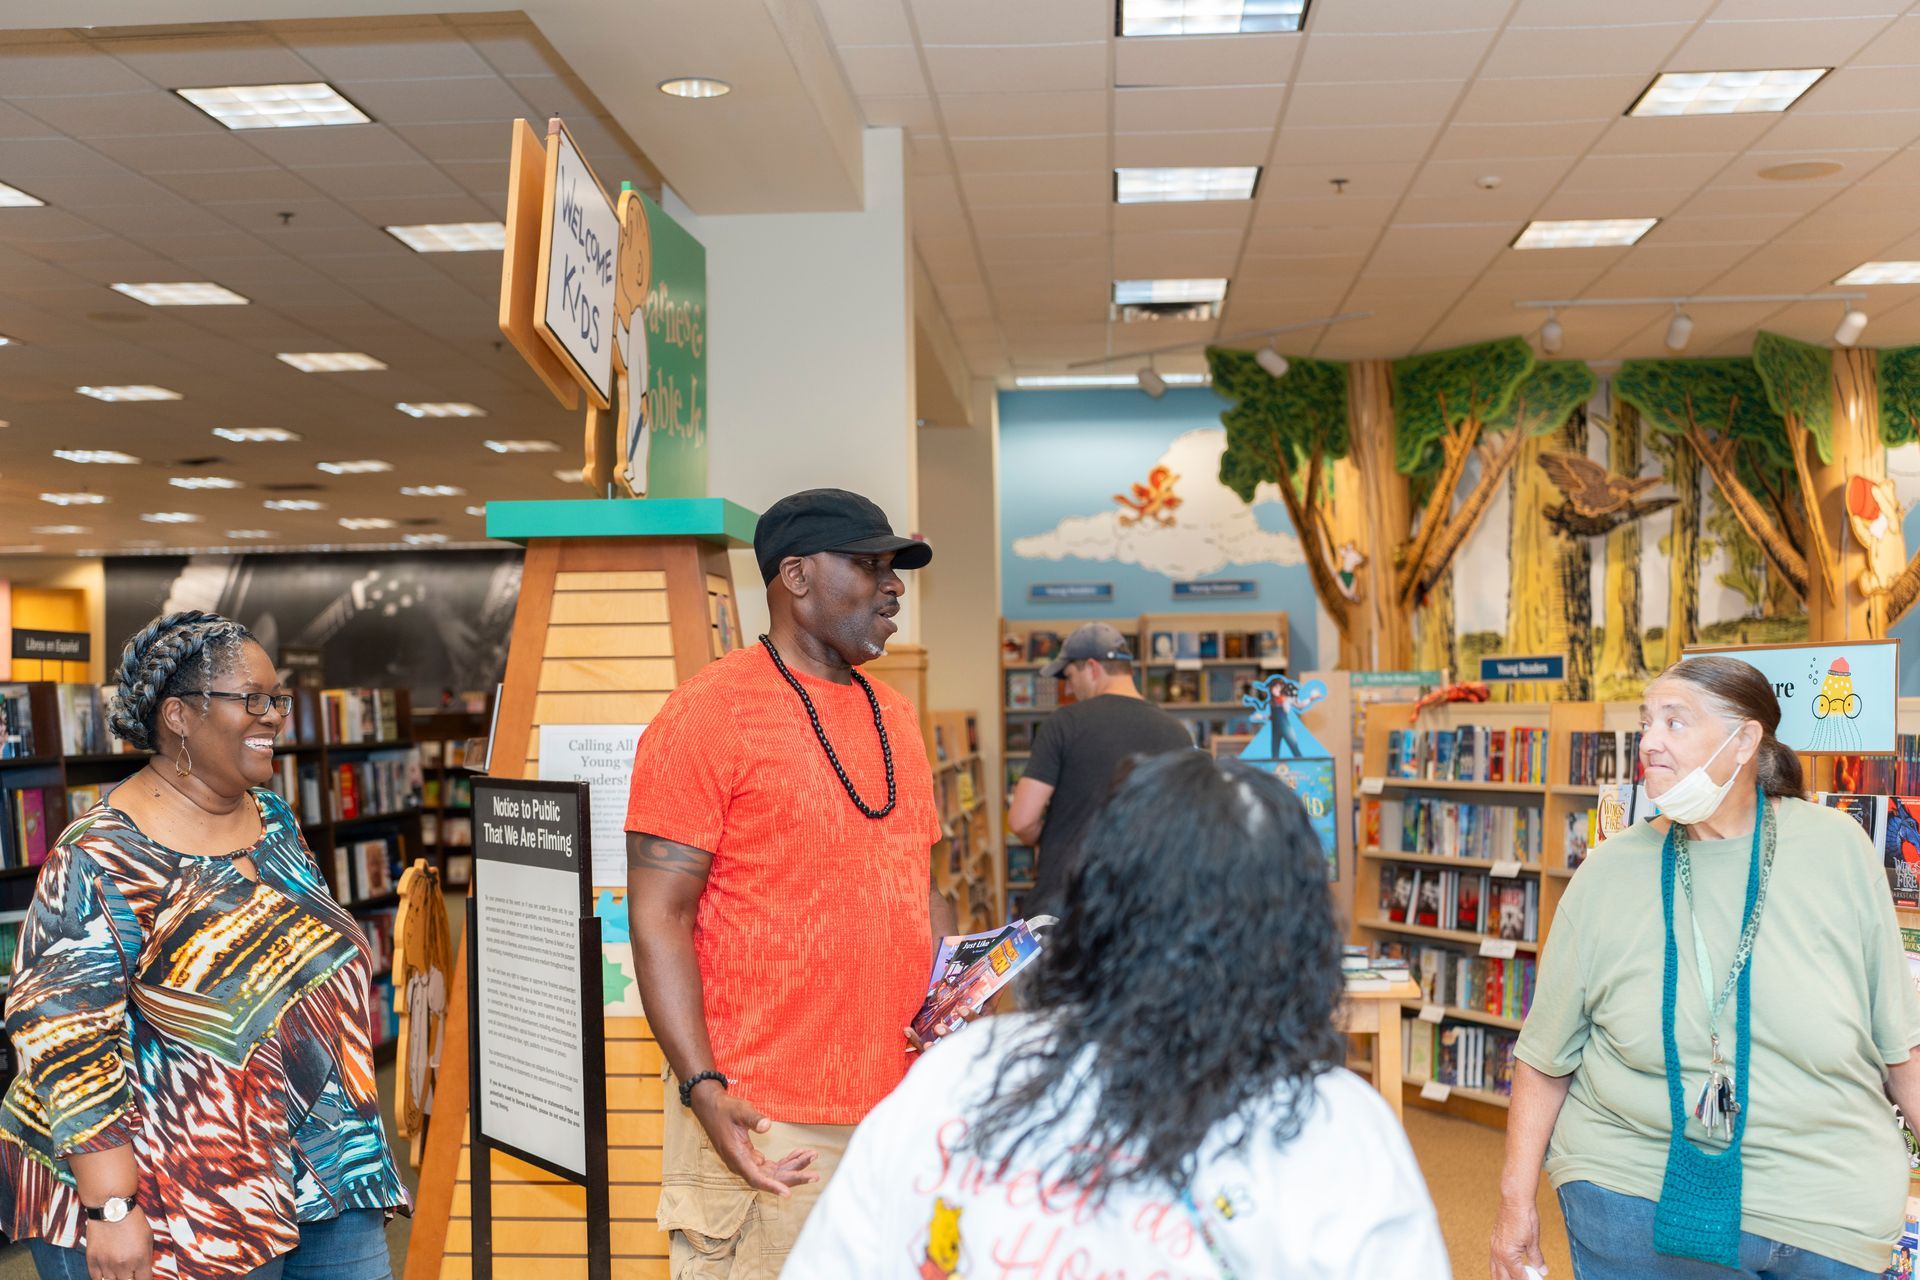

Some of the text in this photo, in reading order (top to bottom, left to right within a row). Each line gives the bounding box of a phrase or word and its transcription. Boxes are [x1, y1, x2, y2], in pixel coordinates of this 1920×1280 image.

[561, 165, 612, 288] WELCOME
[644, 280, 691, 349] arnes
[649, 367, 685, 440] oble,
[1497, 662, 1549, 677] Young Readers
[1768, 682, 1795, 698] re
[568, 739, 634, 753] Calling All
[580, 755, 621, 770] Young
[493, 796, 561, 822] Notice to Public
[483, 822, 573, 858] That We Are Filming
[962, 941, 975, 950] Just
[976, 939, 991, 949] Like
